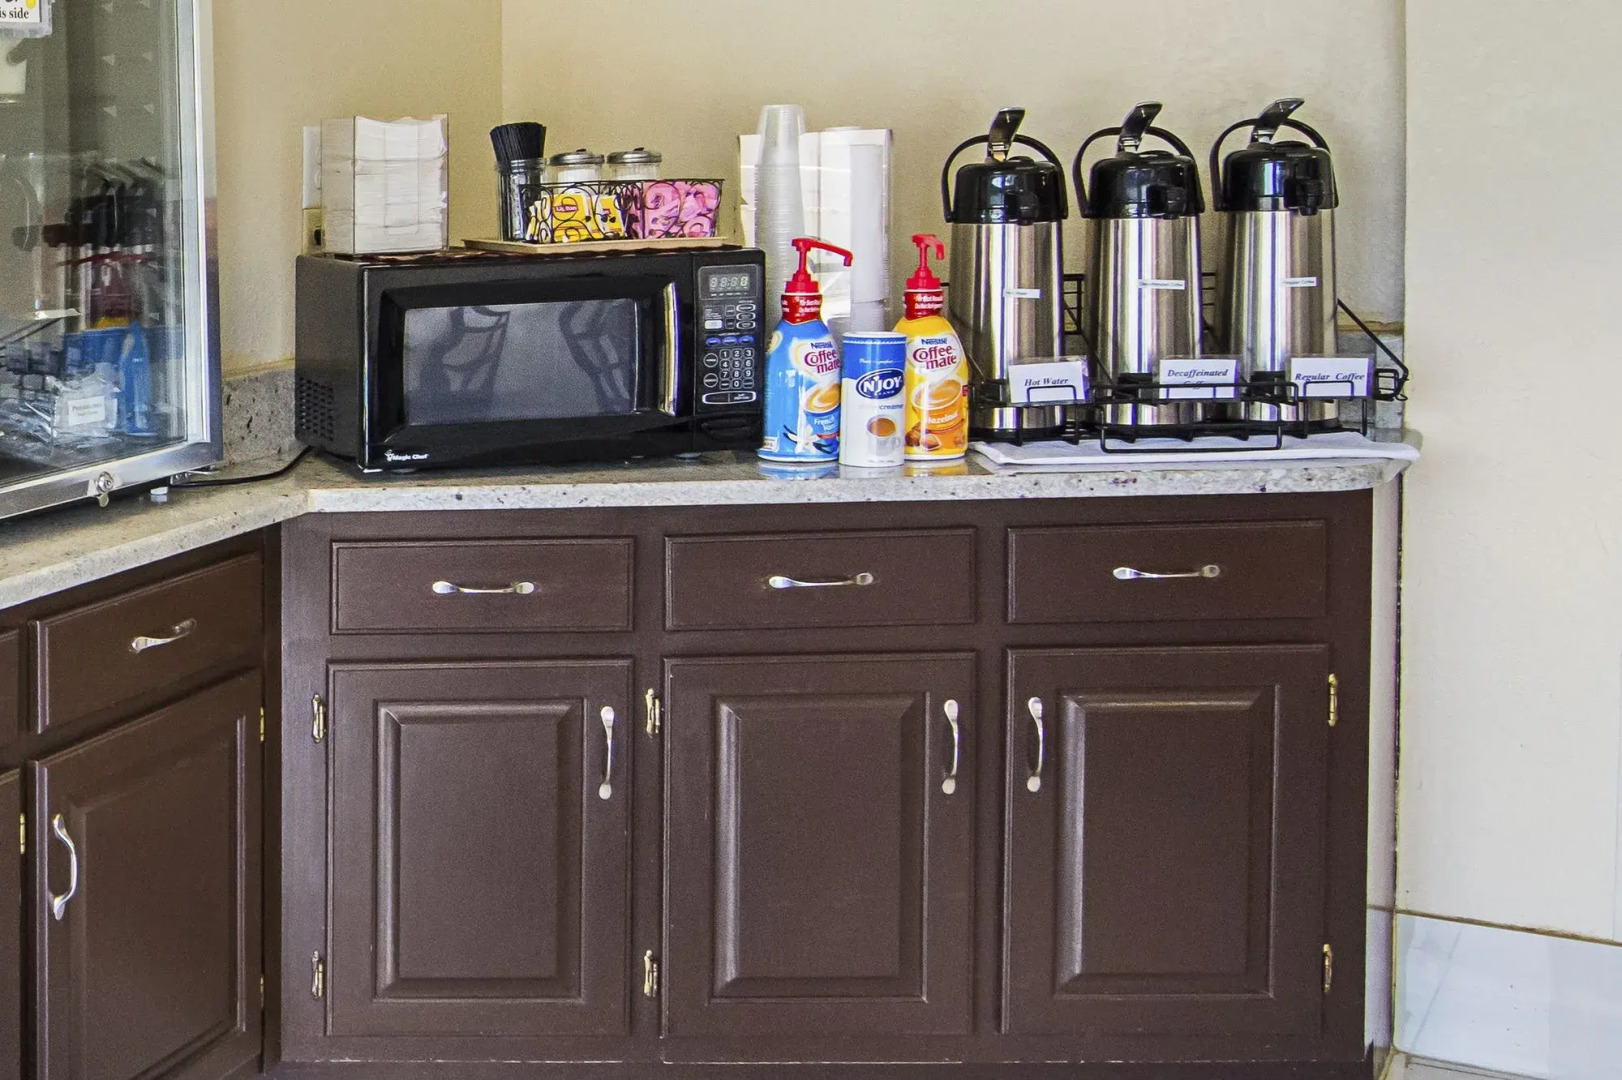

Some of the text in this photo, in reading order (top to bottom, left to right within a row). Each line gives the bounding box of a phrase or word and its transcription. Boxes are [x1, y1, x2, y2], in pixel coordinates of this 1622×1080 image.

[9, 7, 29, 19] side
[745, 349, 752, 357] 3
[804, 349, 838, 367] Coffee
[912, 345, 954, 363] Coffee
[734, 360, 740, 368] 5
[745, 359, 751, 367] 6
[926, 354, 957, 370] mate
[734, 370, 740, 378] 8
[745, 369, 751, 377] 9
[1167, 368, 1229, 379] Decaffeinated
[1295, 372, 1366, 382] Regular Coffee
[1024, 377, 1069, 387] Hot Water
